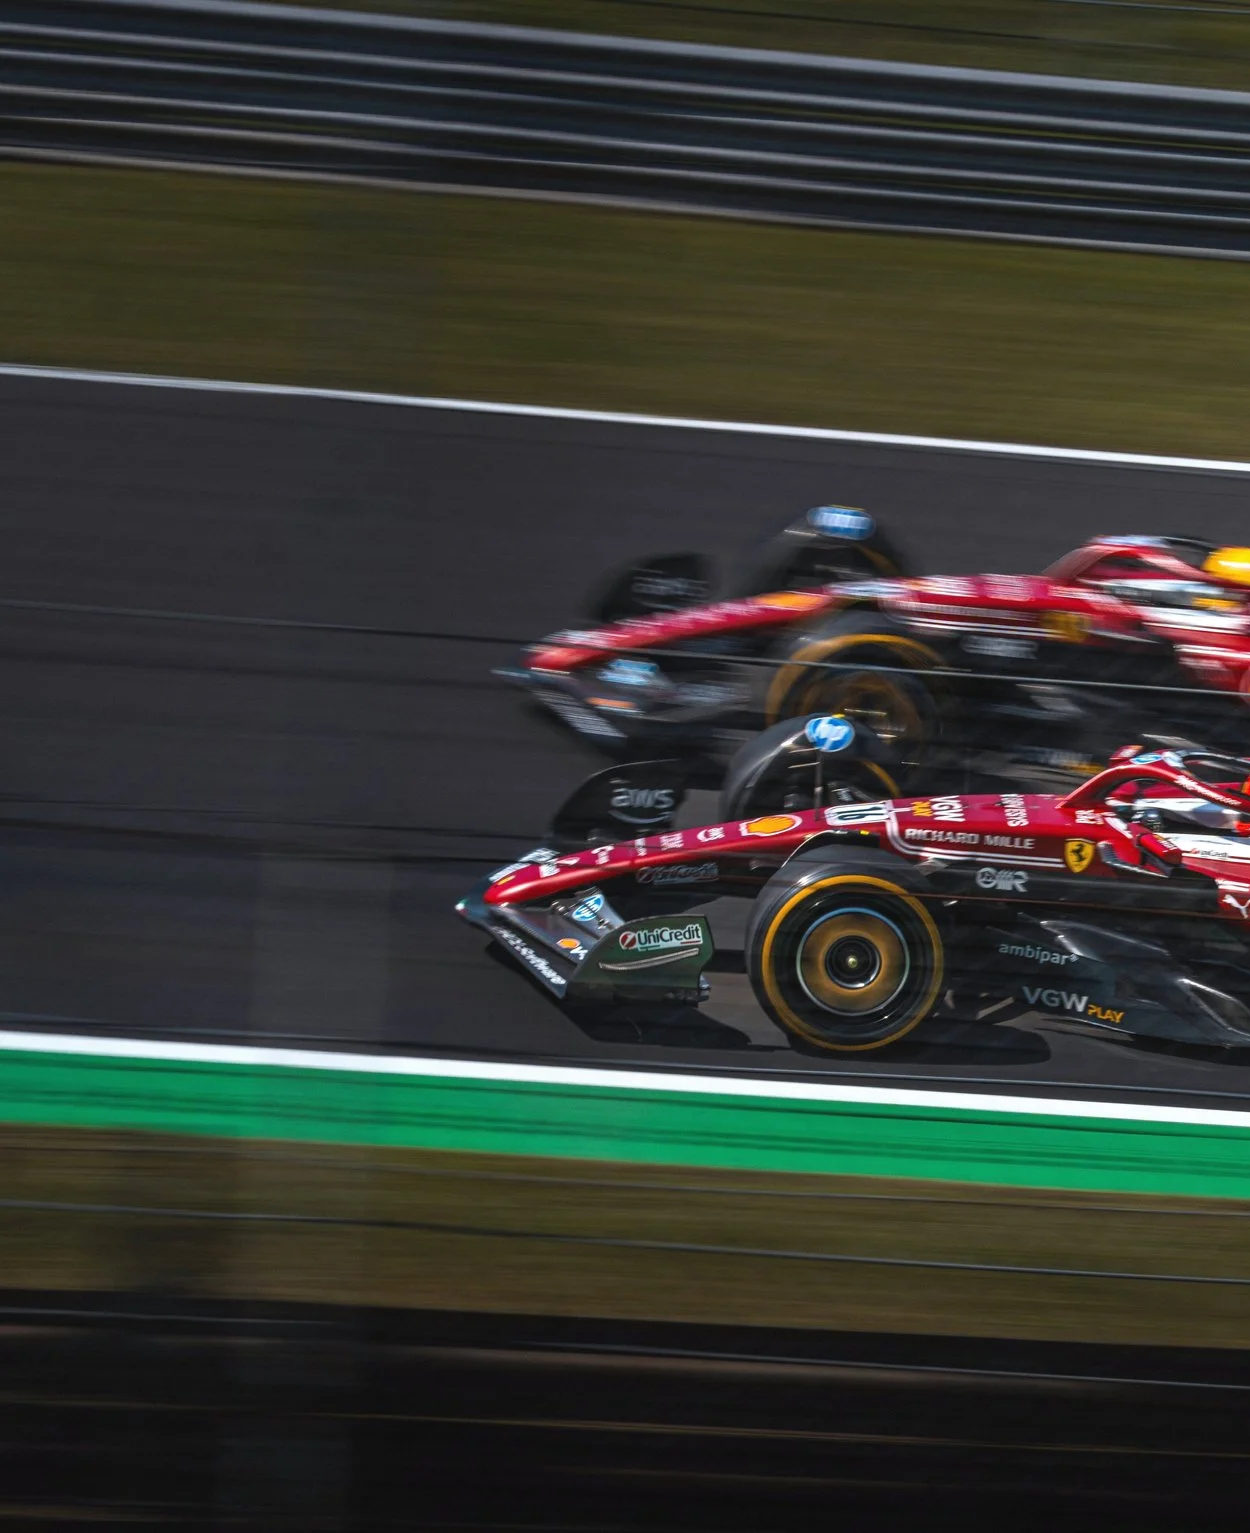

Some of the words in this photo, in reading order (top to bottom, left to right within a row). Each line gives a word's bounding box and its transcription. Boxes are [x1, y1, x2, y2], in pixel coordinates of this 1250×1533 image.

[929, 794, 966, 823] VGW
[905, 828, 979, 845] RICHARD
[984, 835, 1035, 850] MILLE
[637, 925, 702, 947] UniCredit
[999, 943, 1069, 965] ambipar
[1022, 986, 1089, 1012] VGW
[1087, 1004, 1126, 1024] PLAY
